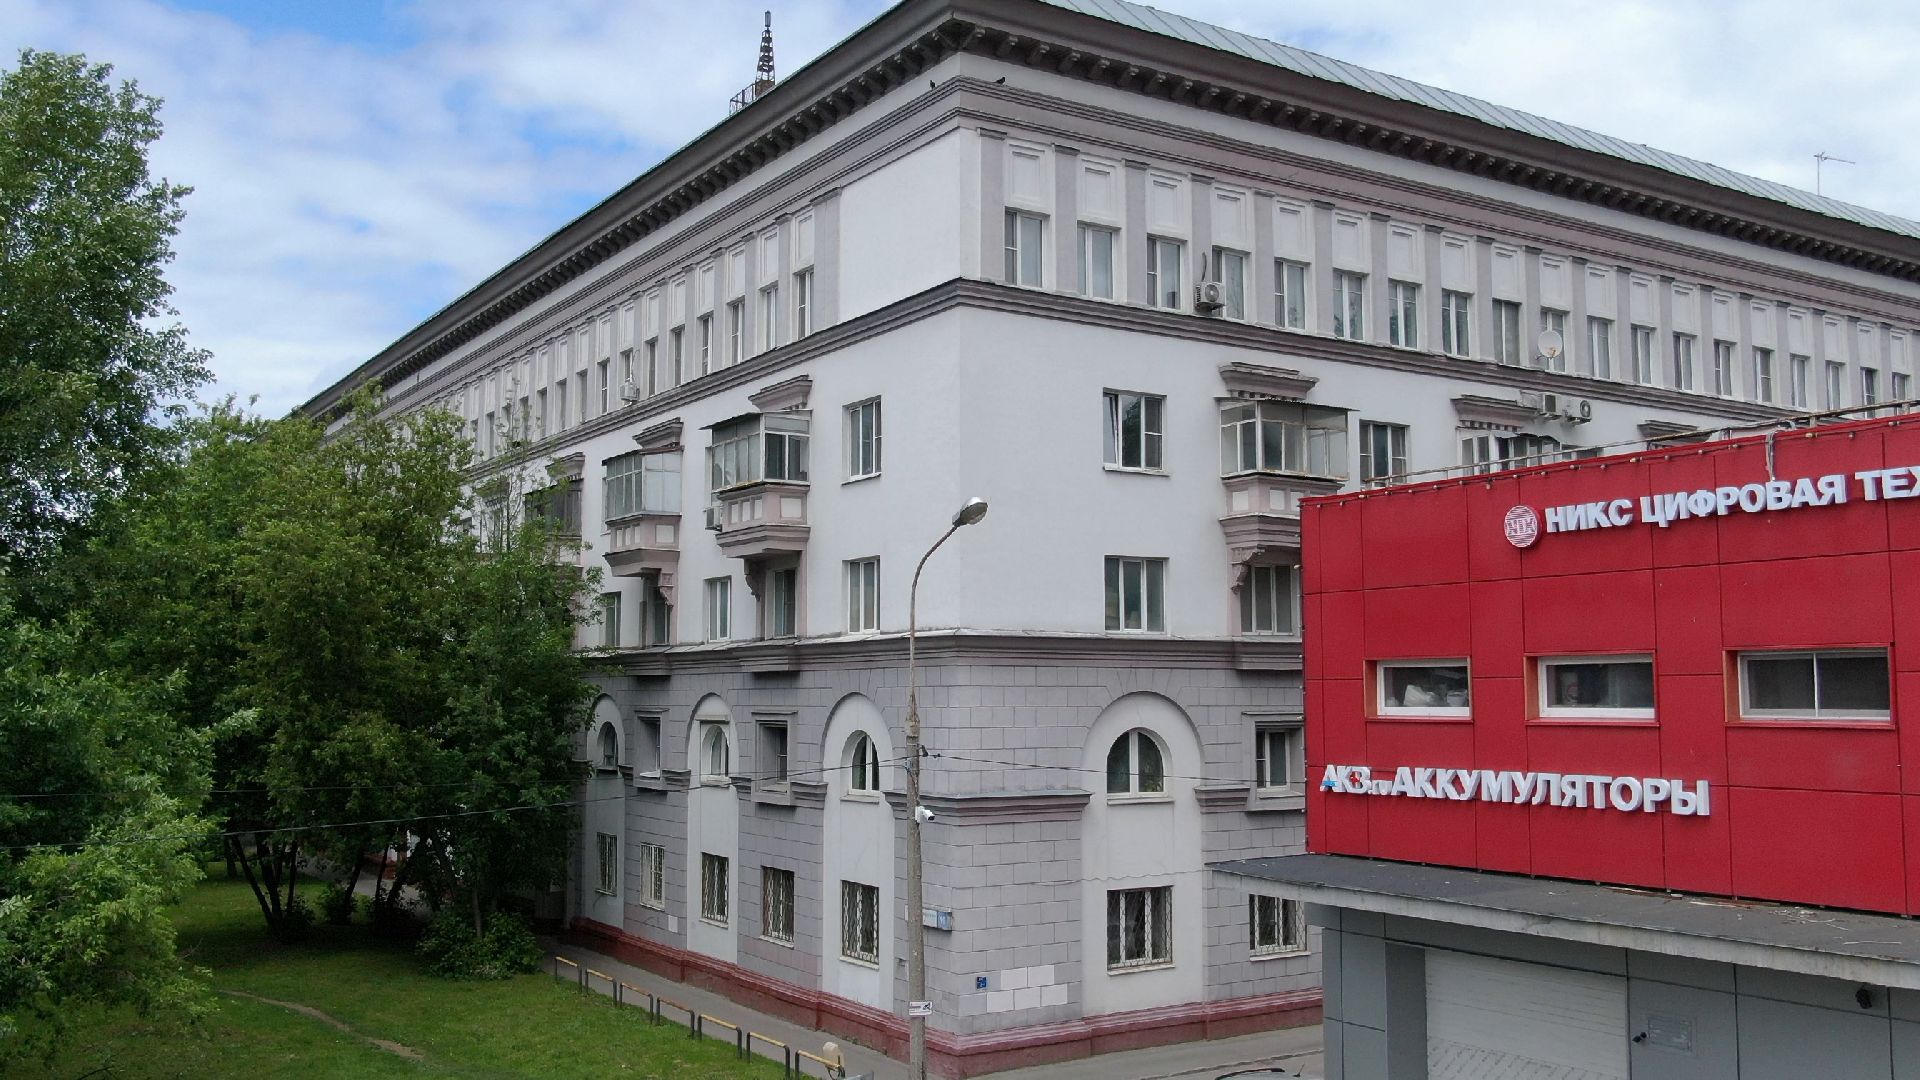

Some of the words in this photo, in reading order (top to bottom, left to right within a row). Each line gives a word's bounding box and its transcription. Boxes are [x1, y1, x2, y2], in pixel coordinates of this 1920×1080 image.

[1544, 499, 1633, 533] НИКС
[1640, 474, 1847, 528] ЦИФРОВАЯ
[1391, 766, 1710, 816] АККУМУЛЯТОРЫ
